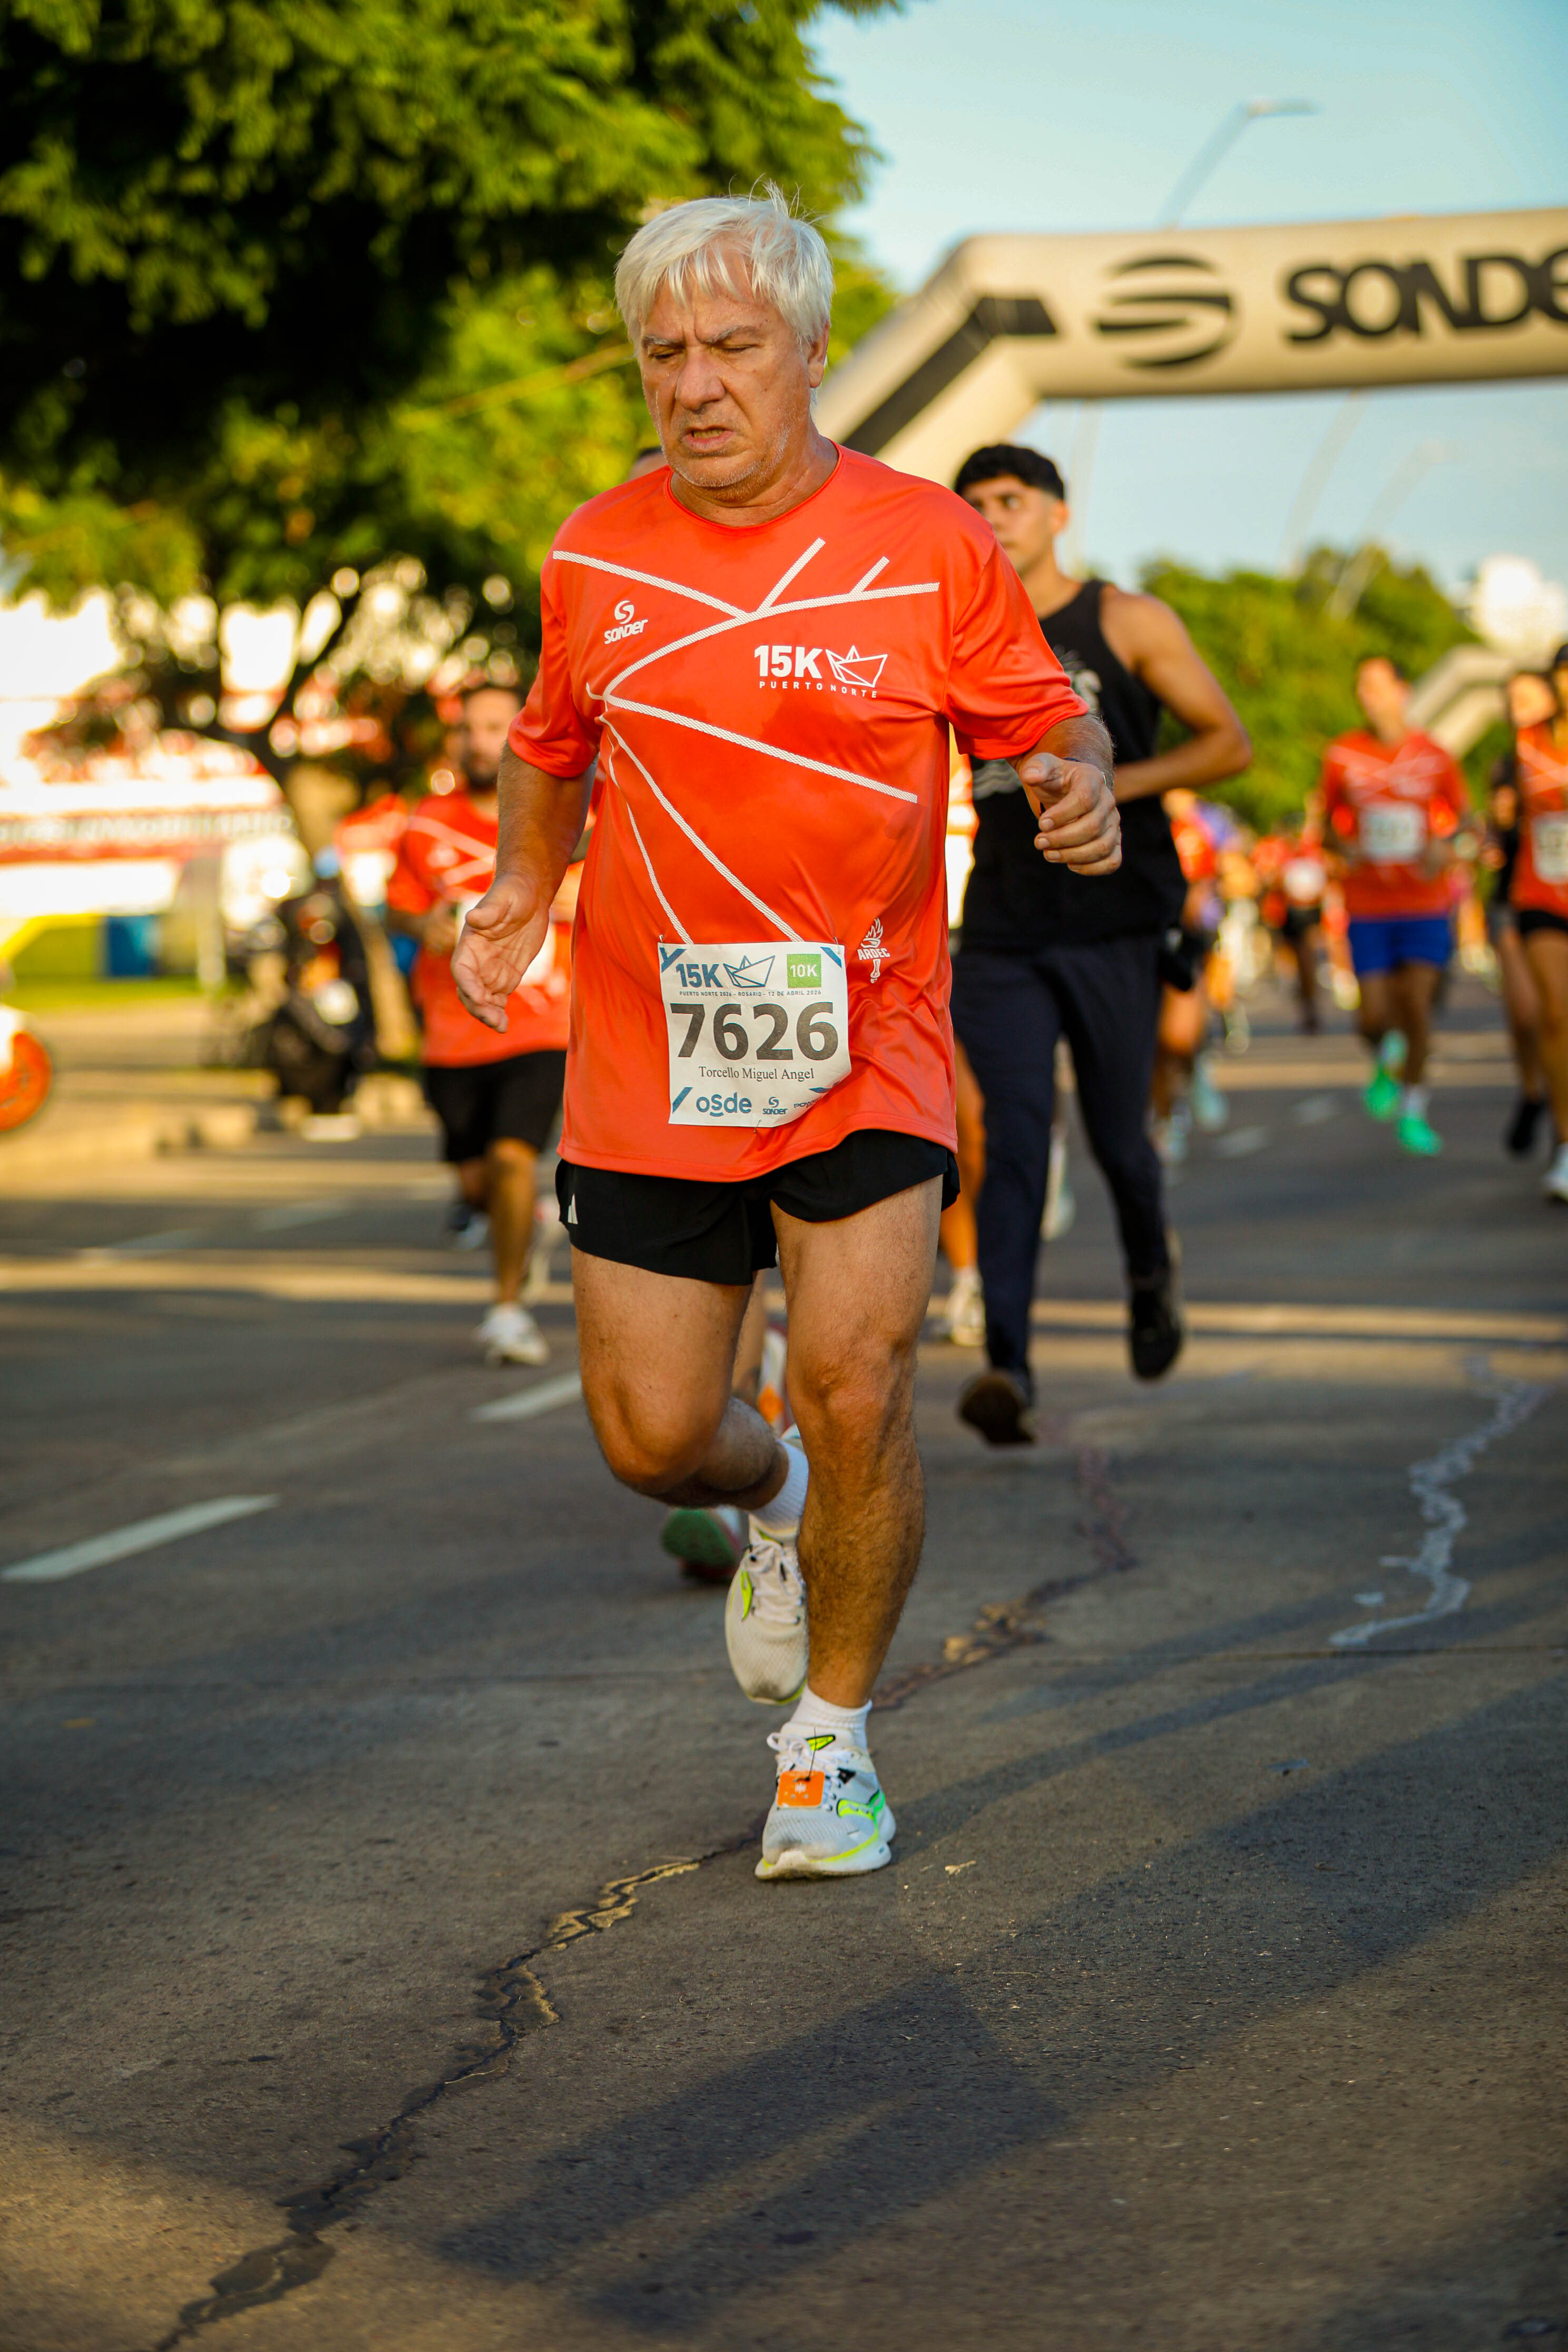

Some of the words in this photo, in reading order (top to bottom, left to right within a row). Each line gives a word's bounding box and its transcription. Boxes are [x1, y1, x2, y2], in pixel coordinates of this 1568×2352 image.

[754, 645, 822, 679] 15K
[759, 681, 822, 690] PUERTO
[830, 684, 877, 698] NORTE
[857, 948, 890, 961] ARDEC
[676, 964, 723, 988] 15K
[790, 965, 818, 978] 10K
[670, 1002, 838, 1061] 7626
[699, 1066, 739, 1080] Torcello
[742, 1067, 778, 1082] Miguel
[781, 1068, 815, 1082] Angel
